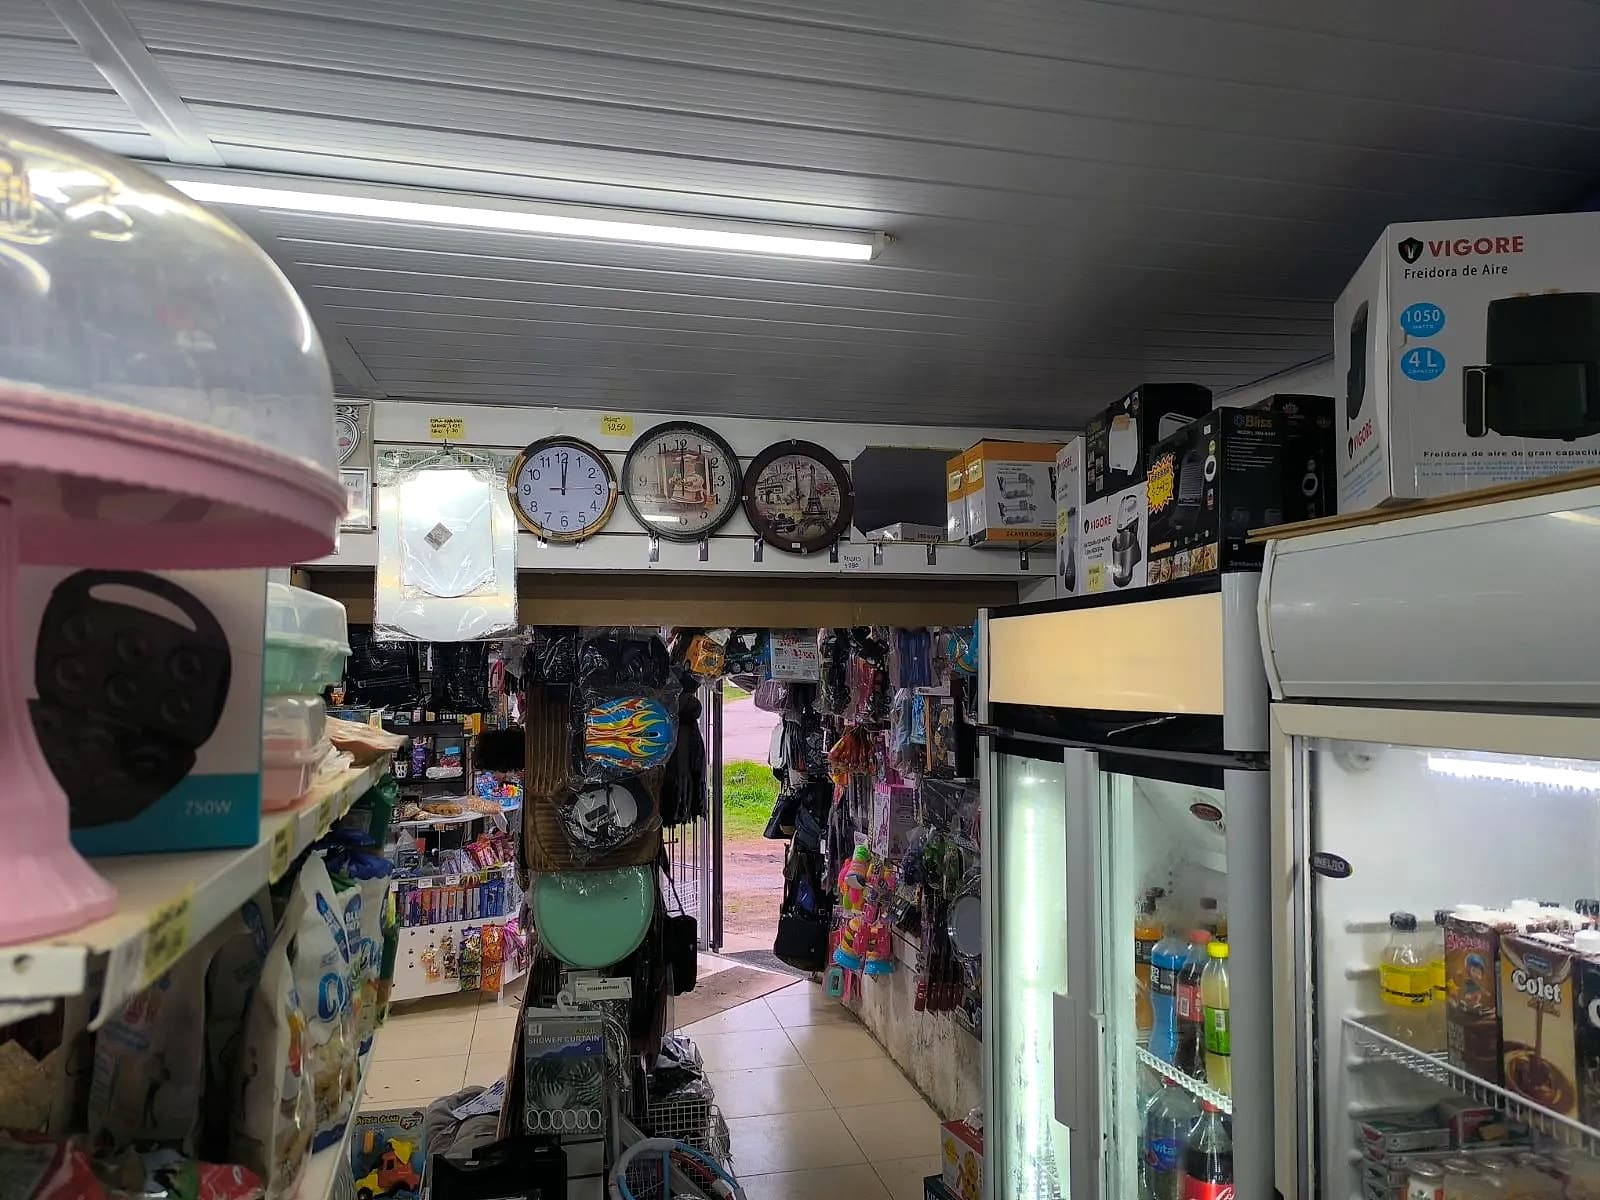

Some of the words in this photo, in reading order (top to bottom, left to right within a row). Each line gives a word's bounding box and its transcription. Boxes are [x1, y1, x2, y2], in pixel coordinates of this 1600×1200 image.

[1429, 236, 1524, 258] VIGORE
[1404, 265, 1457, 279] Freidora
[1462, 265, 1478, 276] de
[1482, 264, 1509, 275] Aire
[1406, 309, 1440, 322] 1050
[1409, 352, 1421, 367] 4
[1427, 351, 1438, 367] L
[1423, 450, 1468, 458] Freidora
[1472, 450, 1484, 458] de
[1488, 450, 1508, 458] aire
[1511, 450, 1525, 458] de
[1528, 450, 1552, 460] gran
[184, 800, 233, 816] 750W
[1512, 970, 1561, 1003] Colet
[528, 1035, 563, 1045] SHOWER
[565, 1033, 600, 1043] CURTAIN
